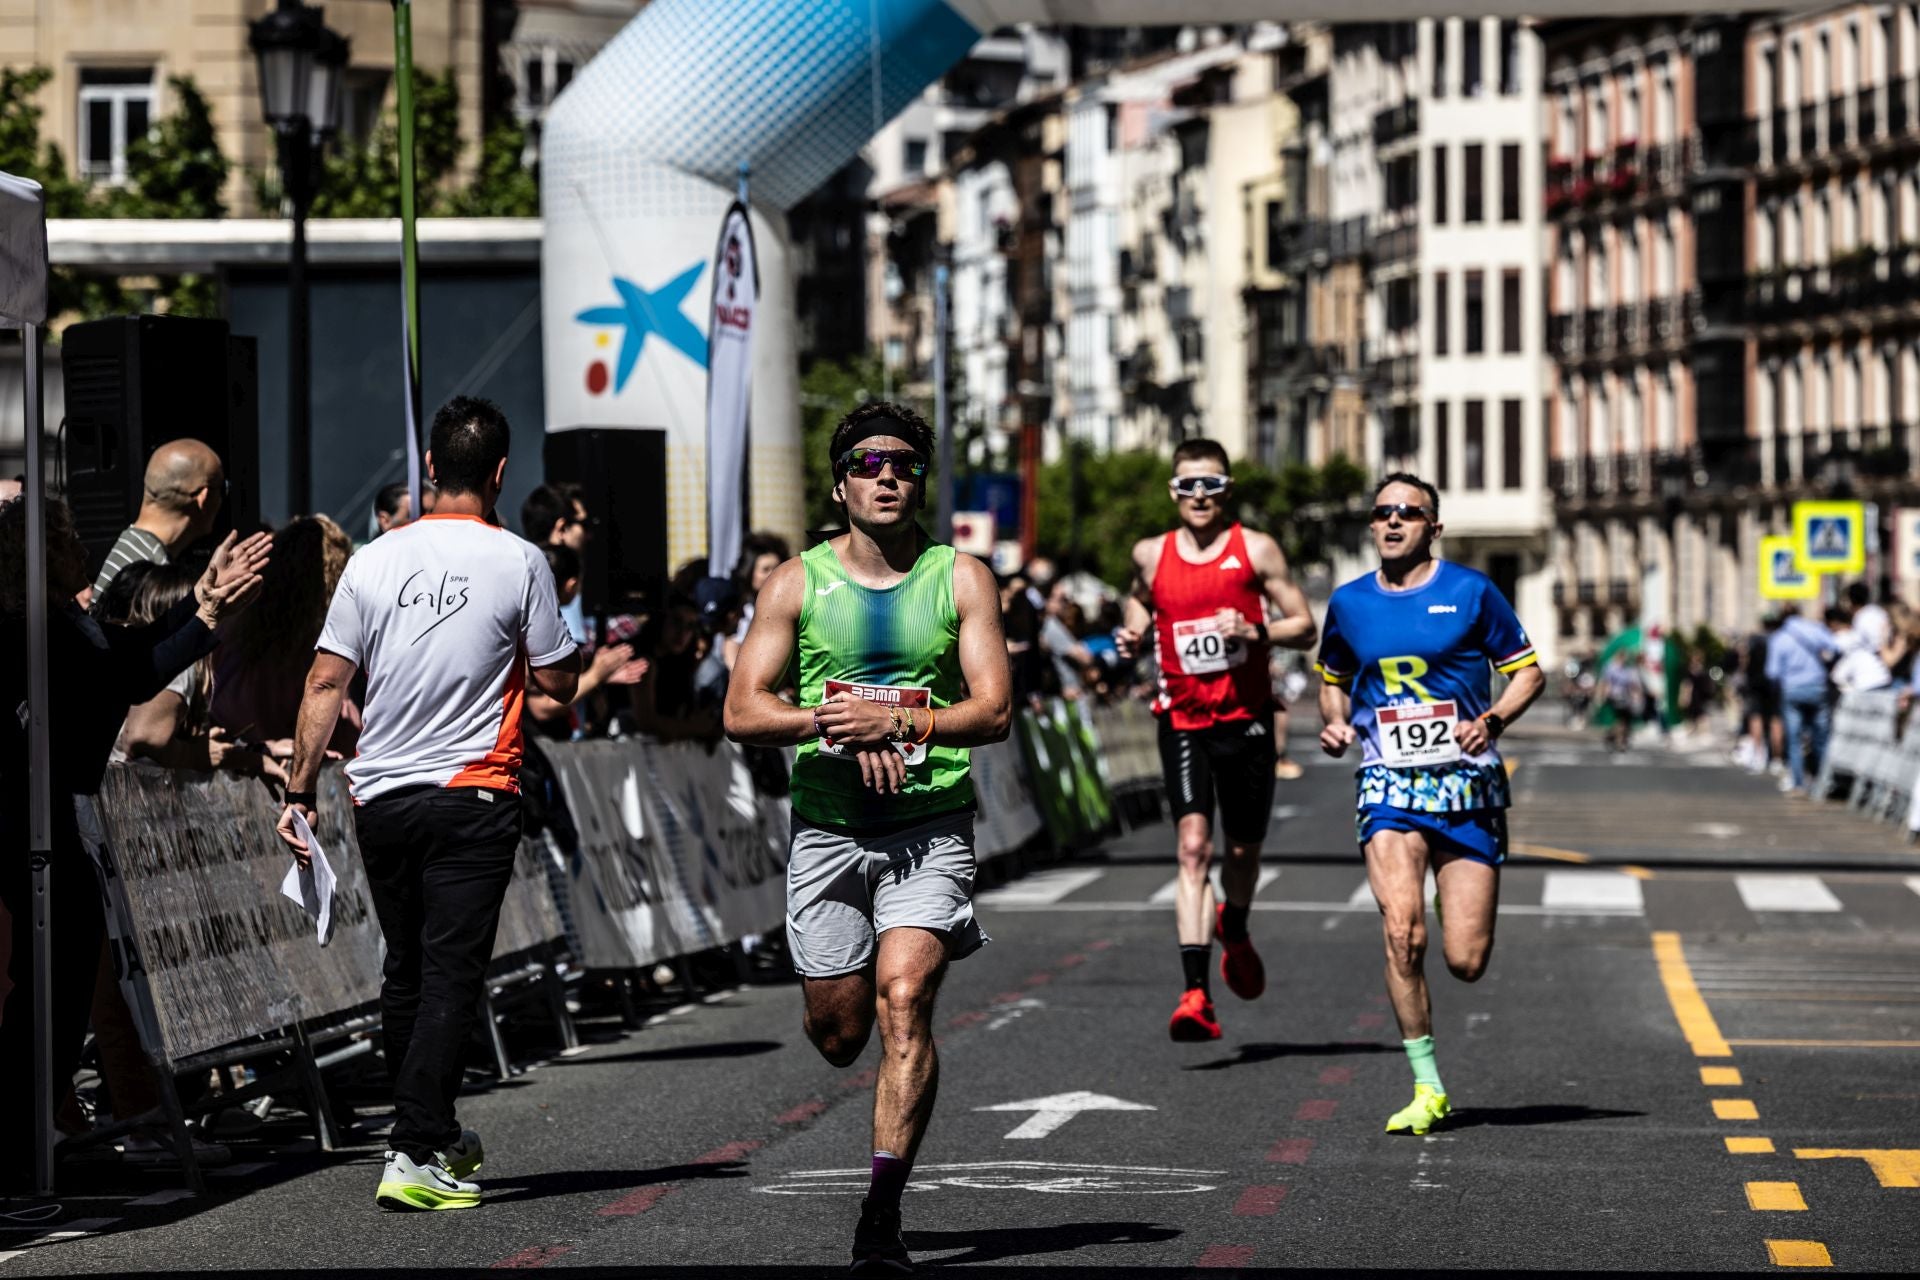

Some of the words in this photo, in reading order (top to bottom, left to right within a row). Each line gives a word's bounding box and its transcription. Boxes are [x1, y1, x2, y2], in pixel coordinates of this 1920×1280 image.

[449, 575, 469, 583] SPKR
[398, 569, 469, 646] Carlos
[1378, 655, 1438, 704] R
[1389, 720, 1451, 750] 192
